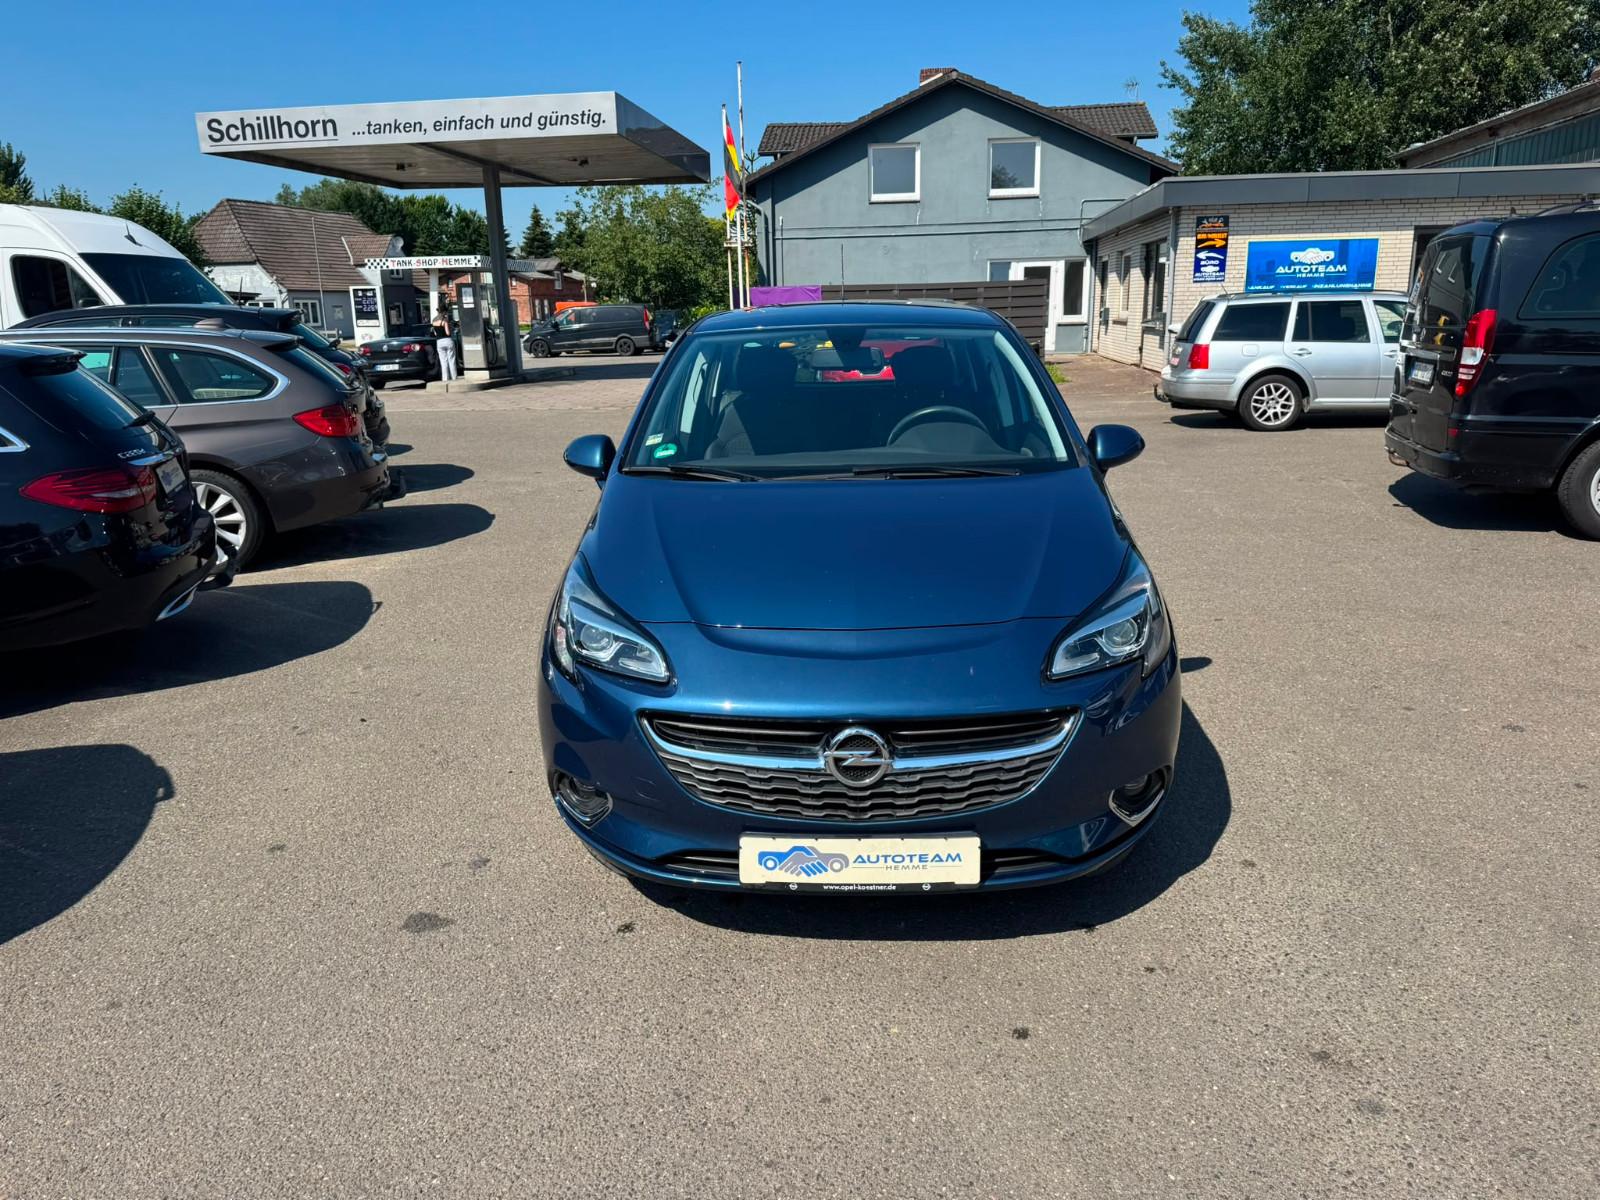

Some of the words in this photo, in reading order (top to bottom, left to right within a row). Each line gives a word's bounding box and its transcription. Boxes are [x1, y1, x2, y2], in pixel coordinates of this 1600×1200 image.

[207, 115, 338, 143] Schillhorn
[352, 118, 427, 135] ...tanken,
[433, 114, 494, 132] einfach
[500, 112, 533, 129] und
[538, 109, 606, 130] günstig.
[1275, 264, 1347, 273] AUTOTEAM
[852, 853, 962, 864] AUTOTEAM
[823, 883, 897, 892] www.opel-koestner.de
